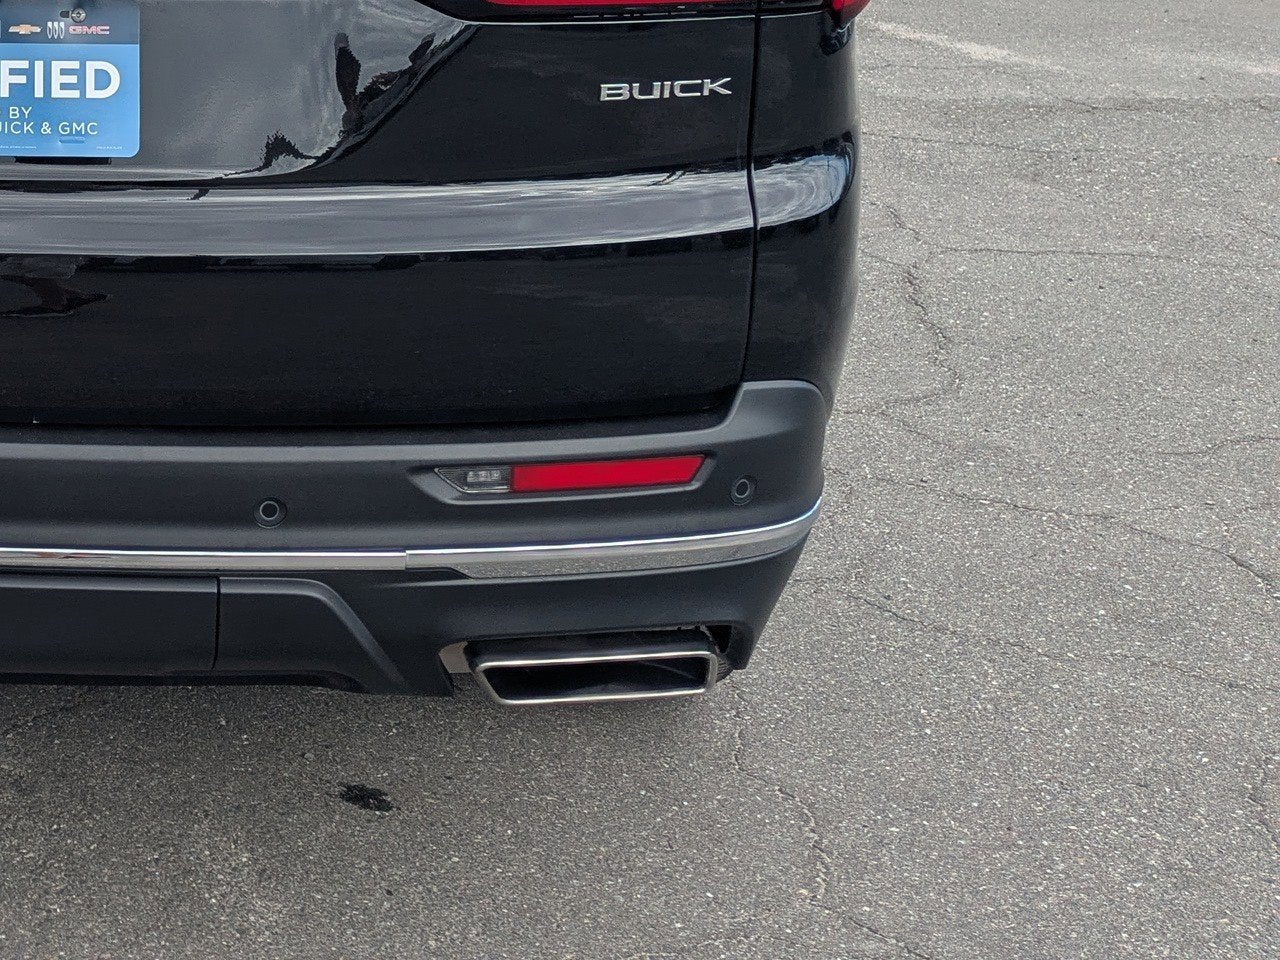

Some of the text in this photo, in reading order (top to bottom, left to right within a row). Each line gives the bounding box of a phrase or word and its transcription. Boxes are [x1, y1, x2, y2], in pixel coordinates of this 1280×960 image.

[68, 25, 110, 35] GMC
[599, 77, 732, 102] BUICK
[9, 106, 32, 119] BY
[41, 122, 52, 135] &
[58, 122, 99, 136] GMC
